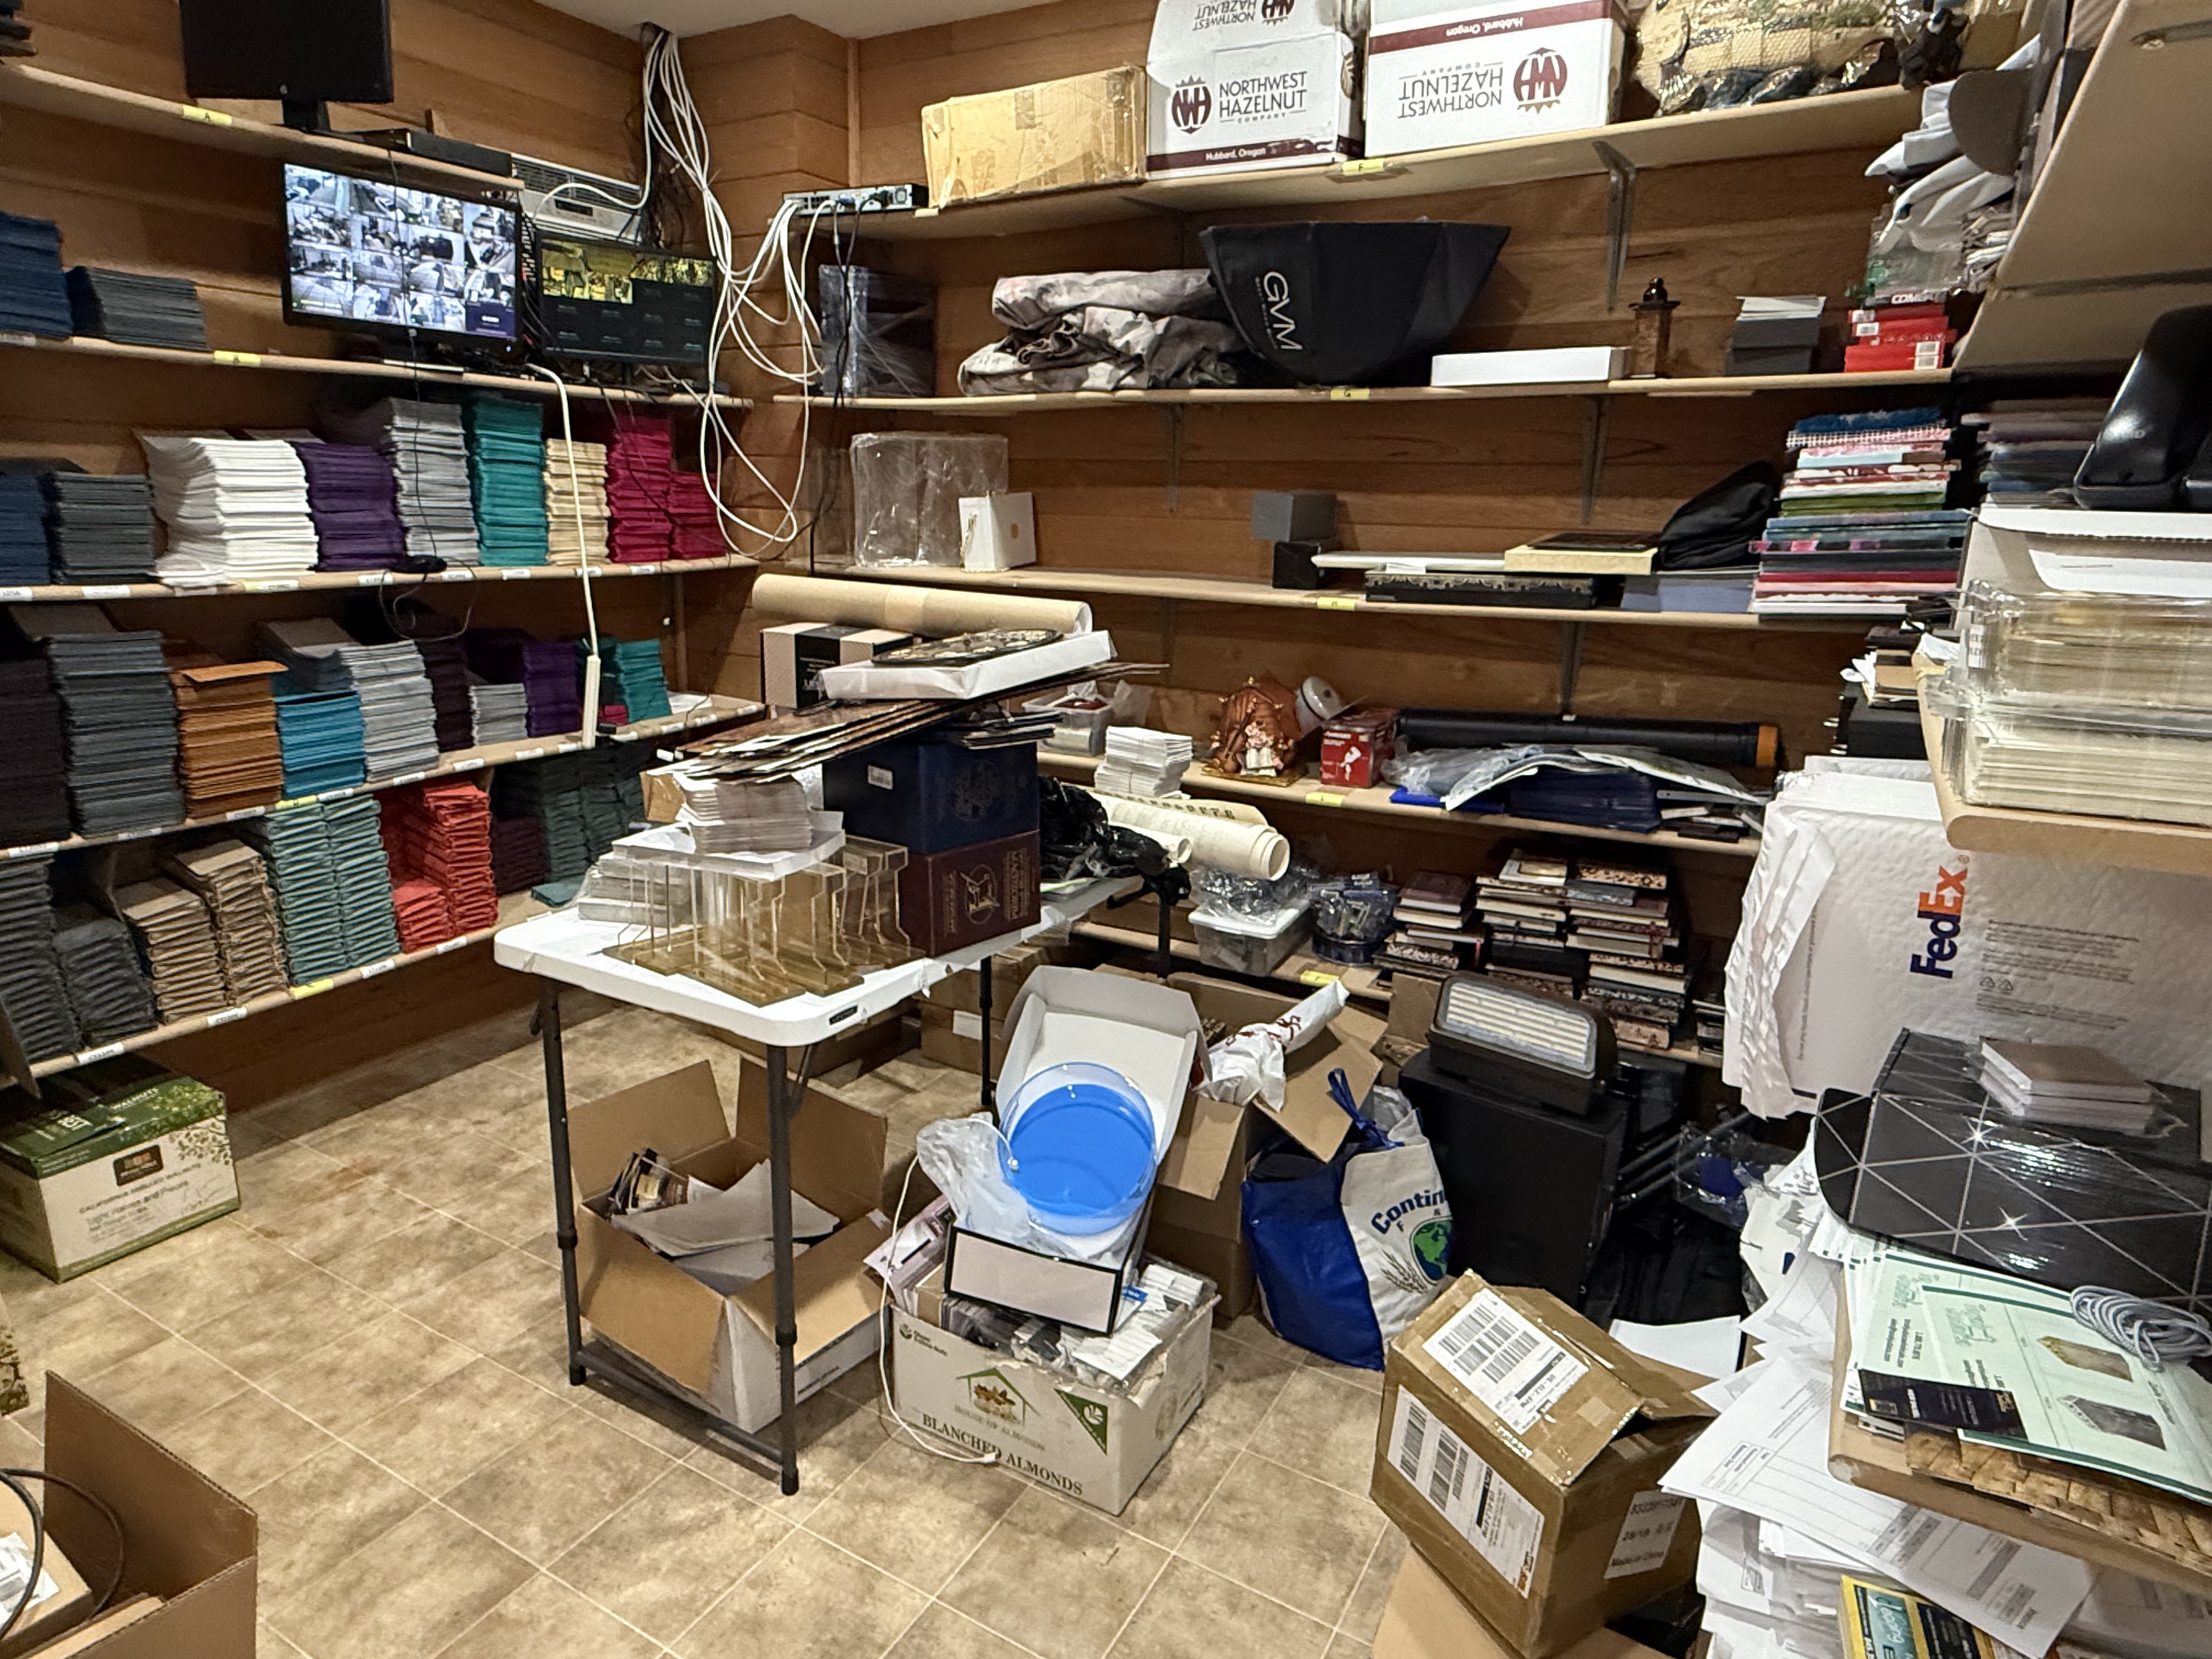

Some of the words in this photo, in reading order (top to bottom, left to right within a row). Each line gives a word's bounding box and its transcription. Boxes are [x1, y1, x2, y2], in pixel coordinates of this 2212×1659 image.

[1192, 11, 1256, 31] NORTHWEST
[1194, 0, 1256, 20] HAZELNUT
[1446, 24, 1481, 36] Oregon
[1483, 17, 1524, 32] Hubbard,
[1219, 71, 1307, 98] NORTHWEST
[1398, 67, 1503, 101] HAZELNUT
[1219, 89, 1307, 119] HAZELNUT
[1397, 89, 1502, 119] NORTHWEST
[1238, 148, 1266, 159] Oregon
[1358, 163, 1364, 172] F
[1263, 272, 1302, 350] GVM
[1910, 865, 1968, 979] FedEx
[923, 1413, 1002, 1459] BLANCHED
[1006, 1452, 1084, 1496] ALMONDS
